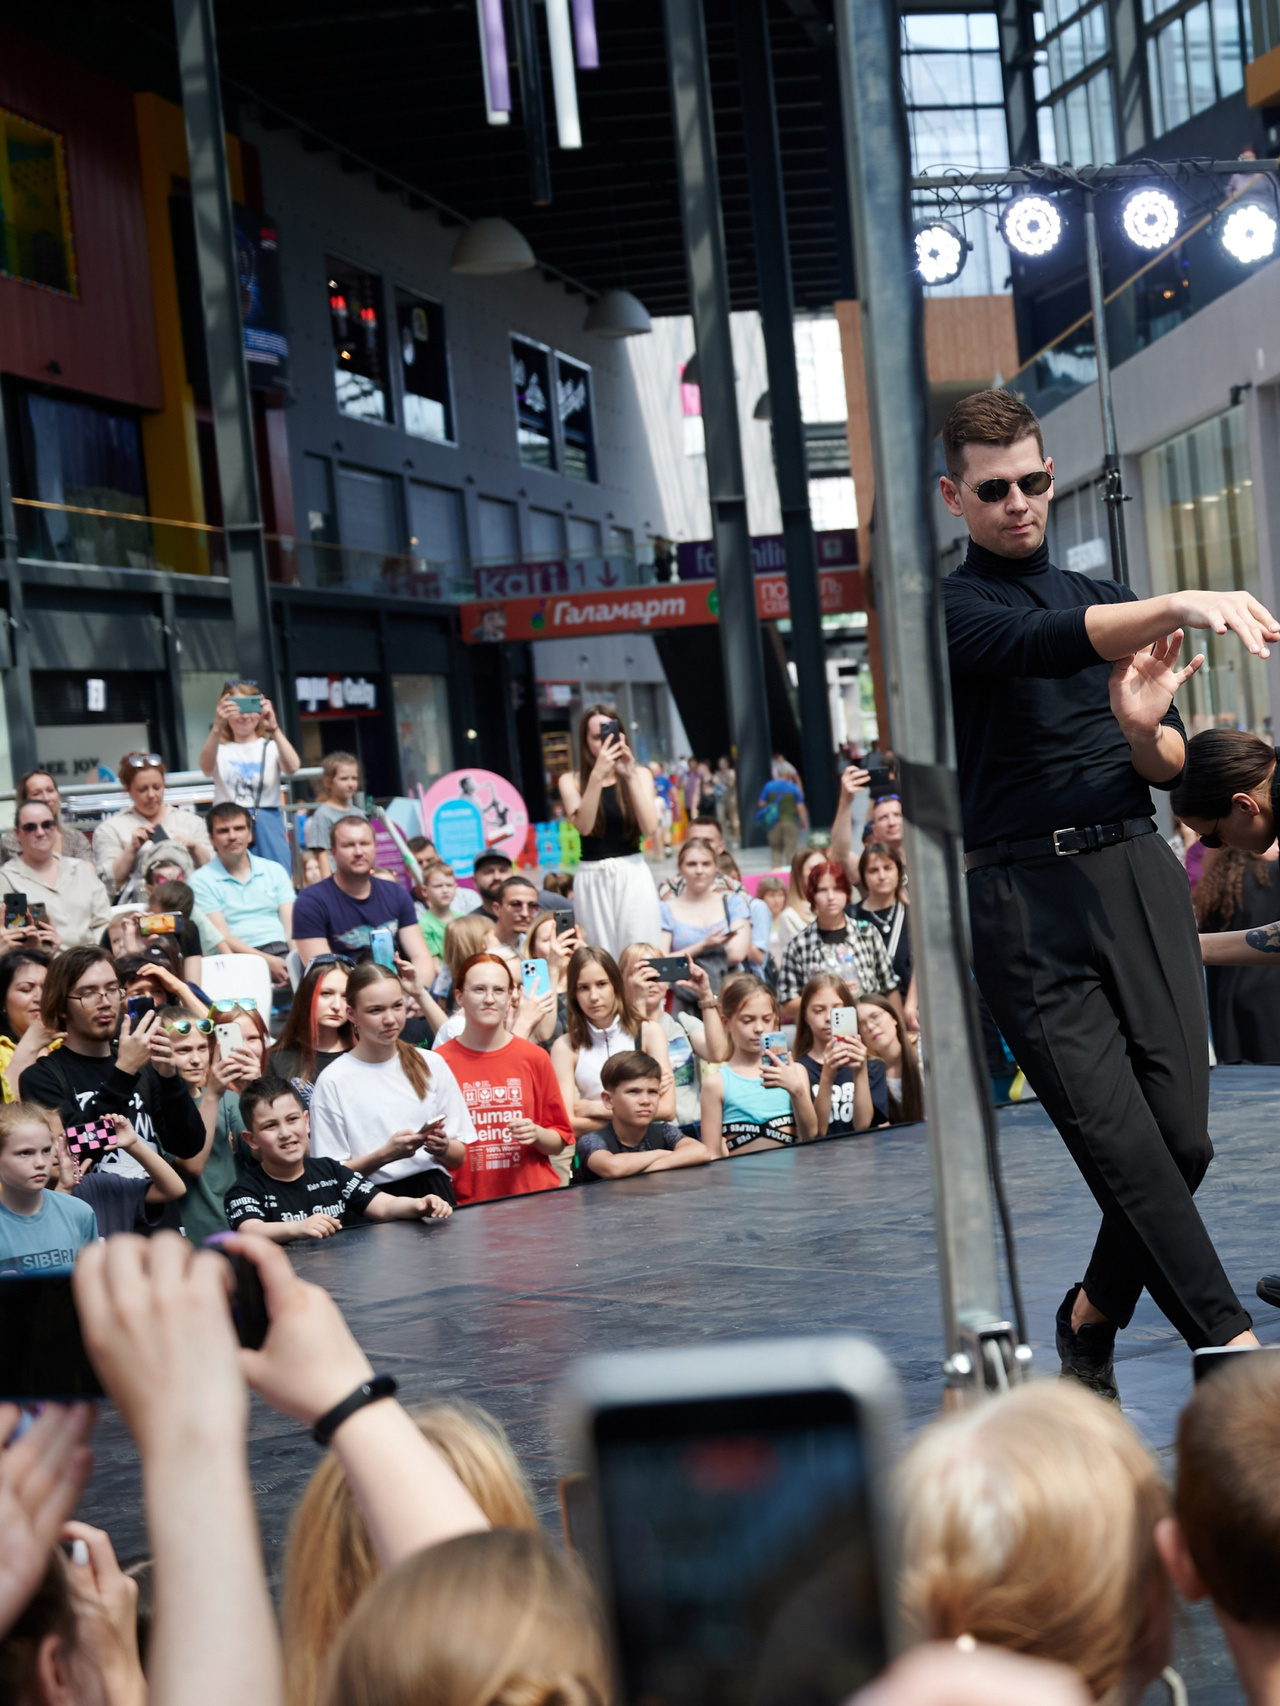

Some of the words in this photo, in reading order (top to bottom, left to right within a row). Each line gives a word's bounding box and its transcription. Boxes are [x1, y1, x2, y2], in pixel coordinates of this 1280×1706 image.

[553, 597, 687, 627] Галамарт
[478, 1125, 513, 1143] eing
[22, 1248, 79, 1271] SIBERI
